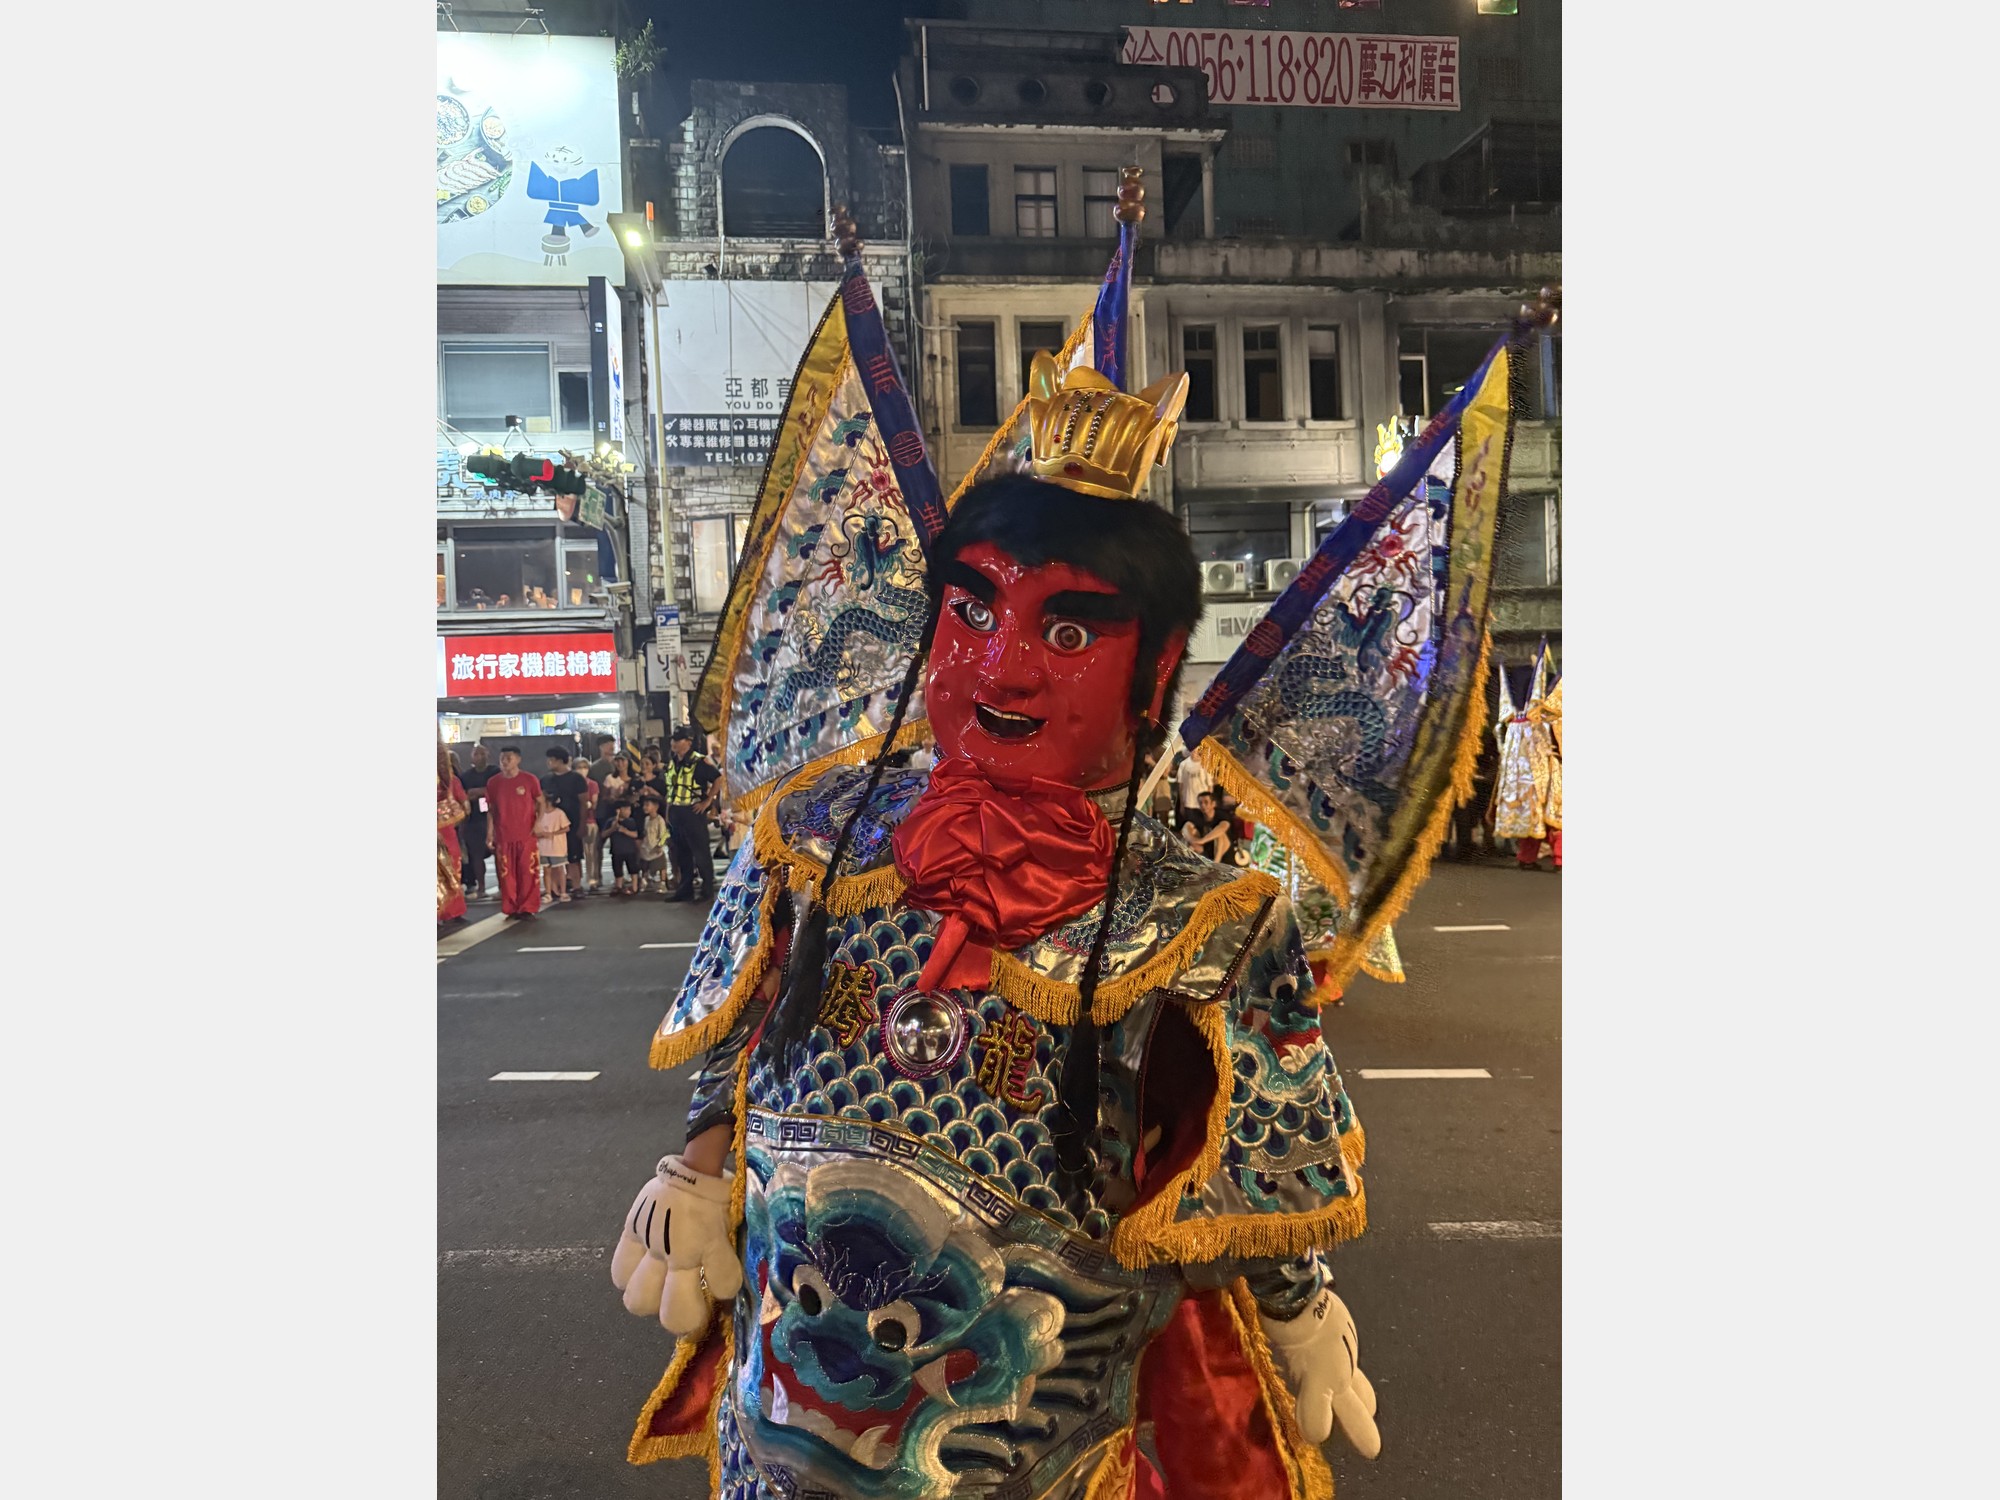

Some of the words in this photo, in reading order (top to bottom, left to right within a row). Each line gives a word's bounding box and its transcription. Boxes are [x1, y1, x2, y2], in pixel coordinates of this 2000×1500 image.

[725, 377, 792, 399] 亞都音
[725, 401, 751, 410] YOU
[756, 401, 774, 410] DO
[679, 418, 731, 431] 樂器販售
[679, 434, 731, 448] 專業維修
[657, 614, 667, 627] P
[451, 650, 613, 681] 旅行家機能棉襪
[977, 1010, 1043, 1112] 龍
